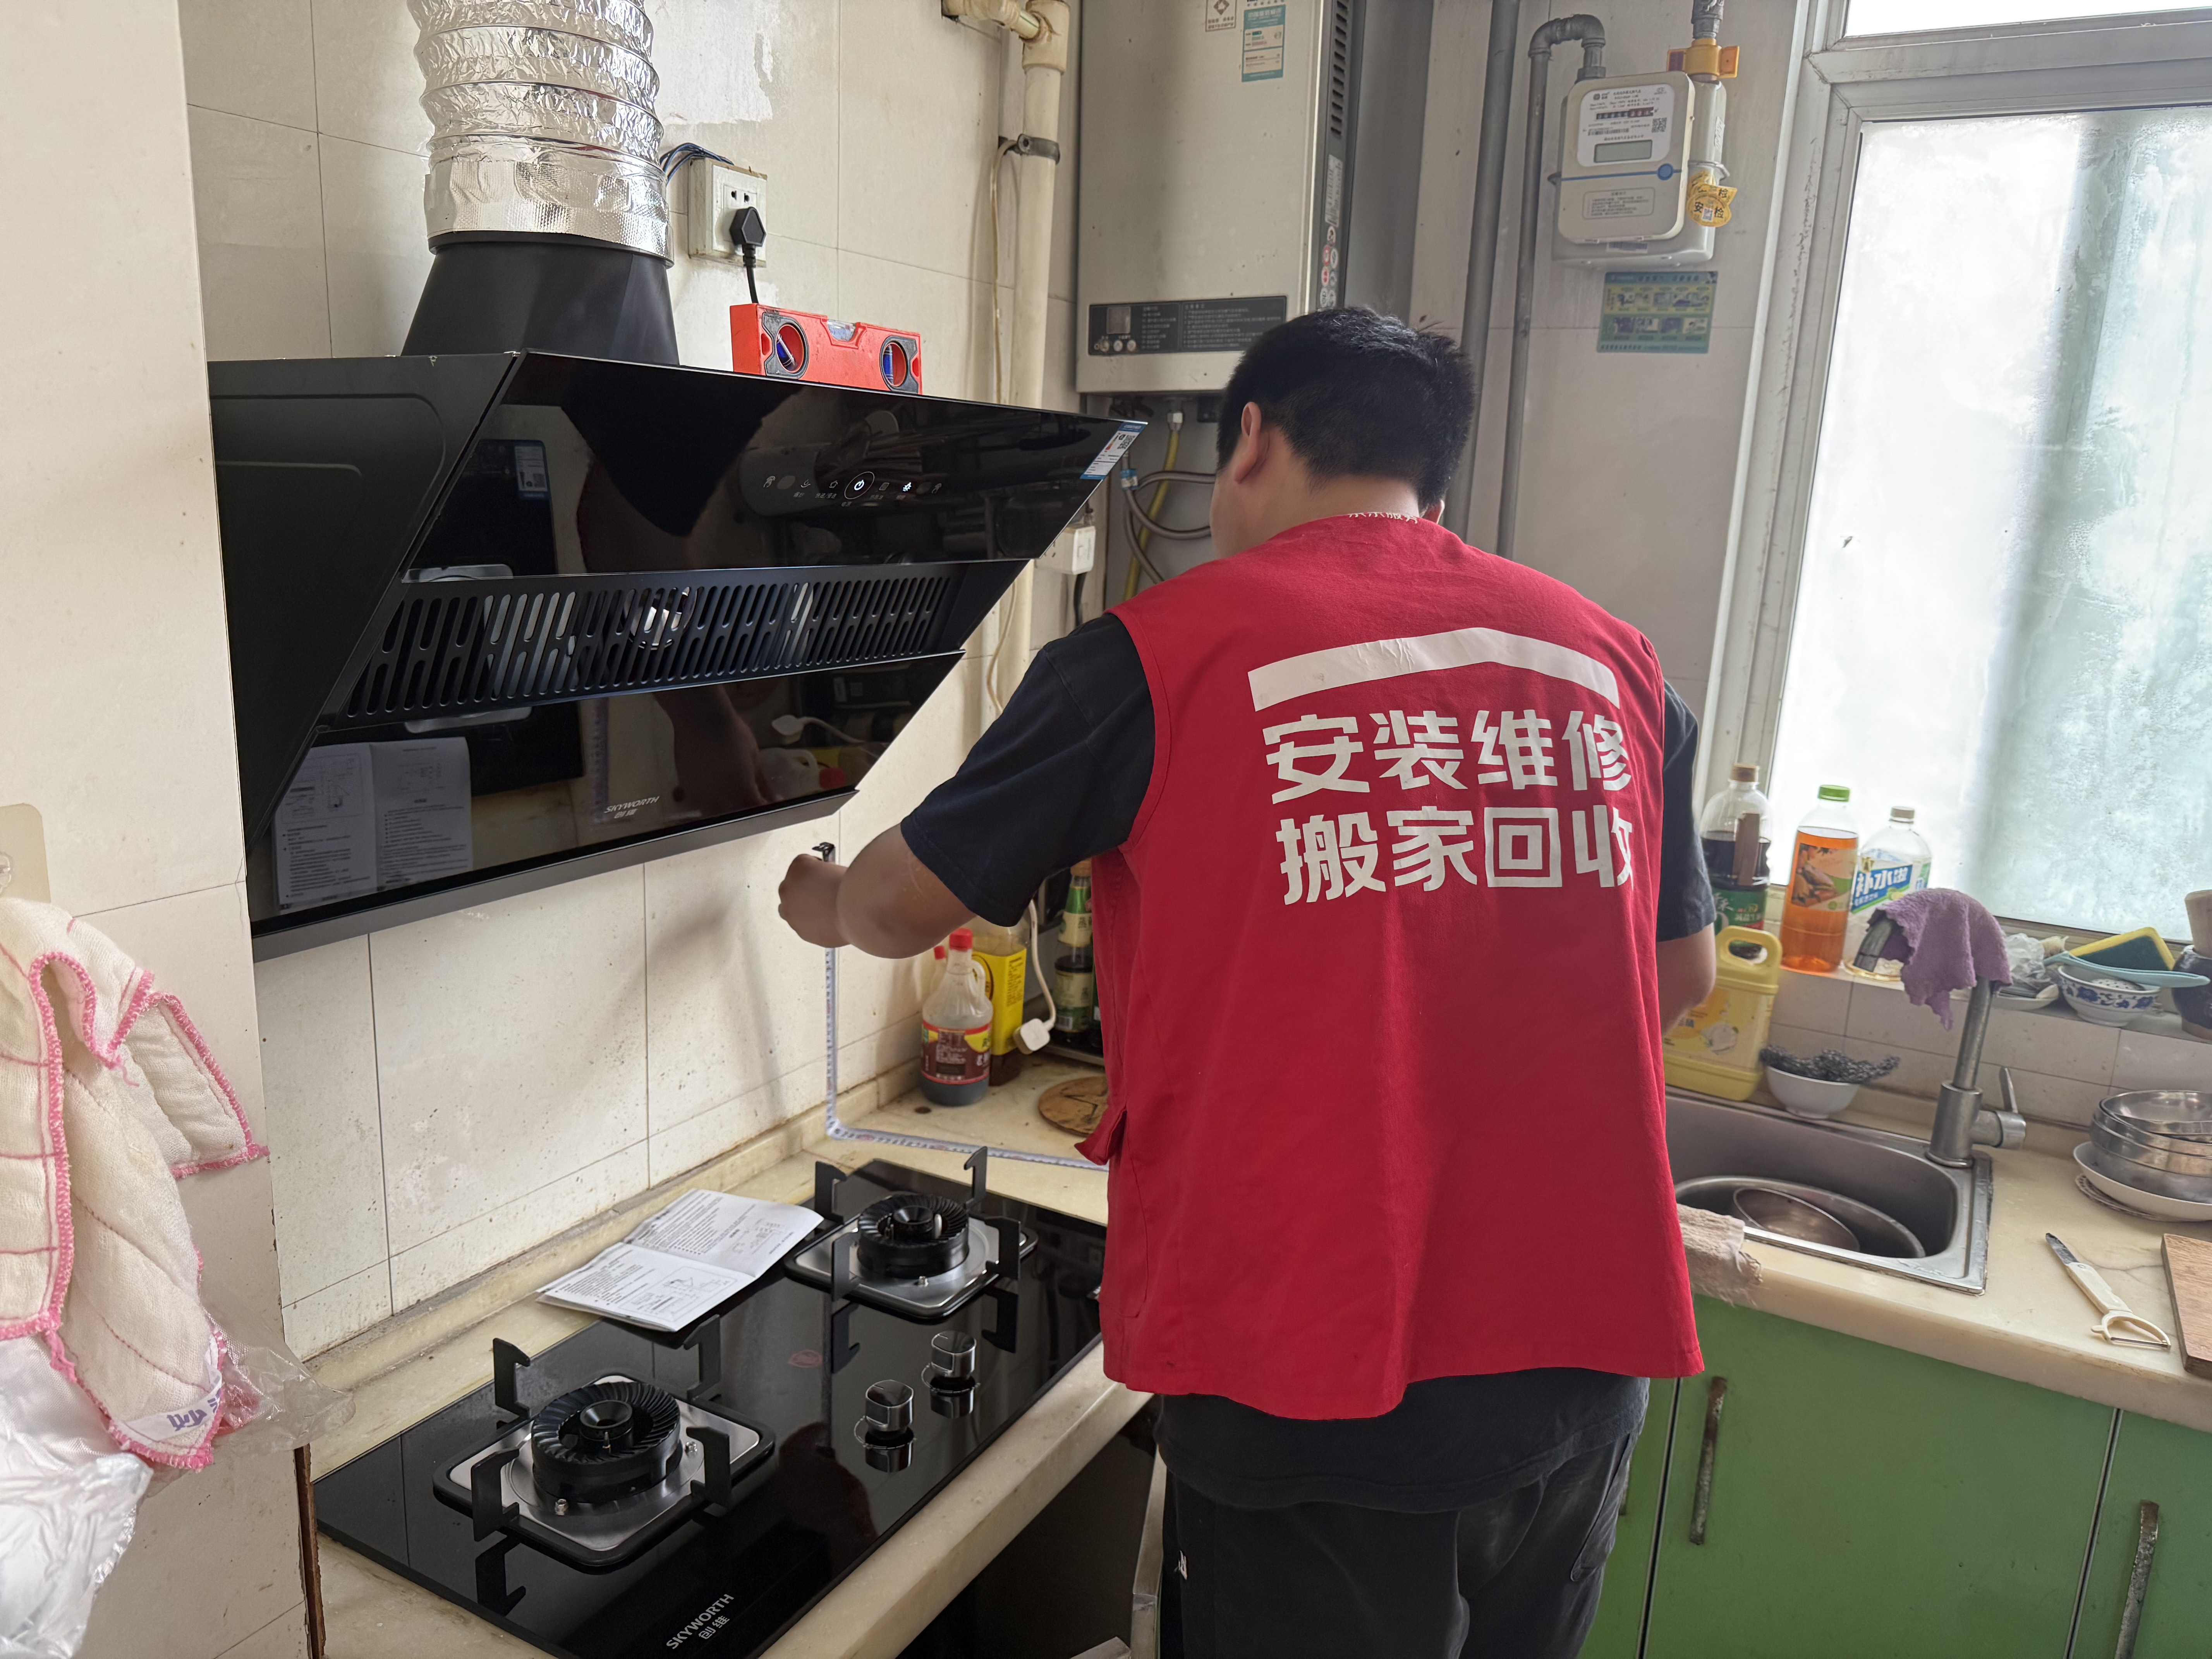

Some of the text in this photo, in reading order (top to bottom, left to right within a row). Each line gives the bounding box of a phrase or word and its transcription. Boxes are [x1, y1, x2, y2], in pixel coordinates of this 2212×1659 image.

[1694, 201, 1724, 218] 安检
[1263, 709, 1630, 804] 安装维修
[604, 795, 660, 813] SKYWORTH
[1276, 805, 1634, 905] 搬家回收
[666, 1594, 735, 1649] SKYWORTH
[698, 1615, 730, 1640] 创维
